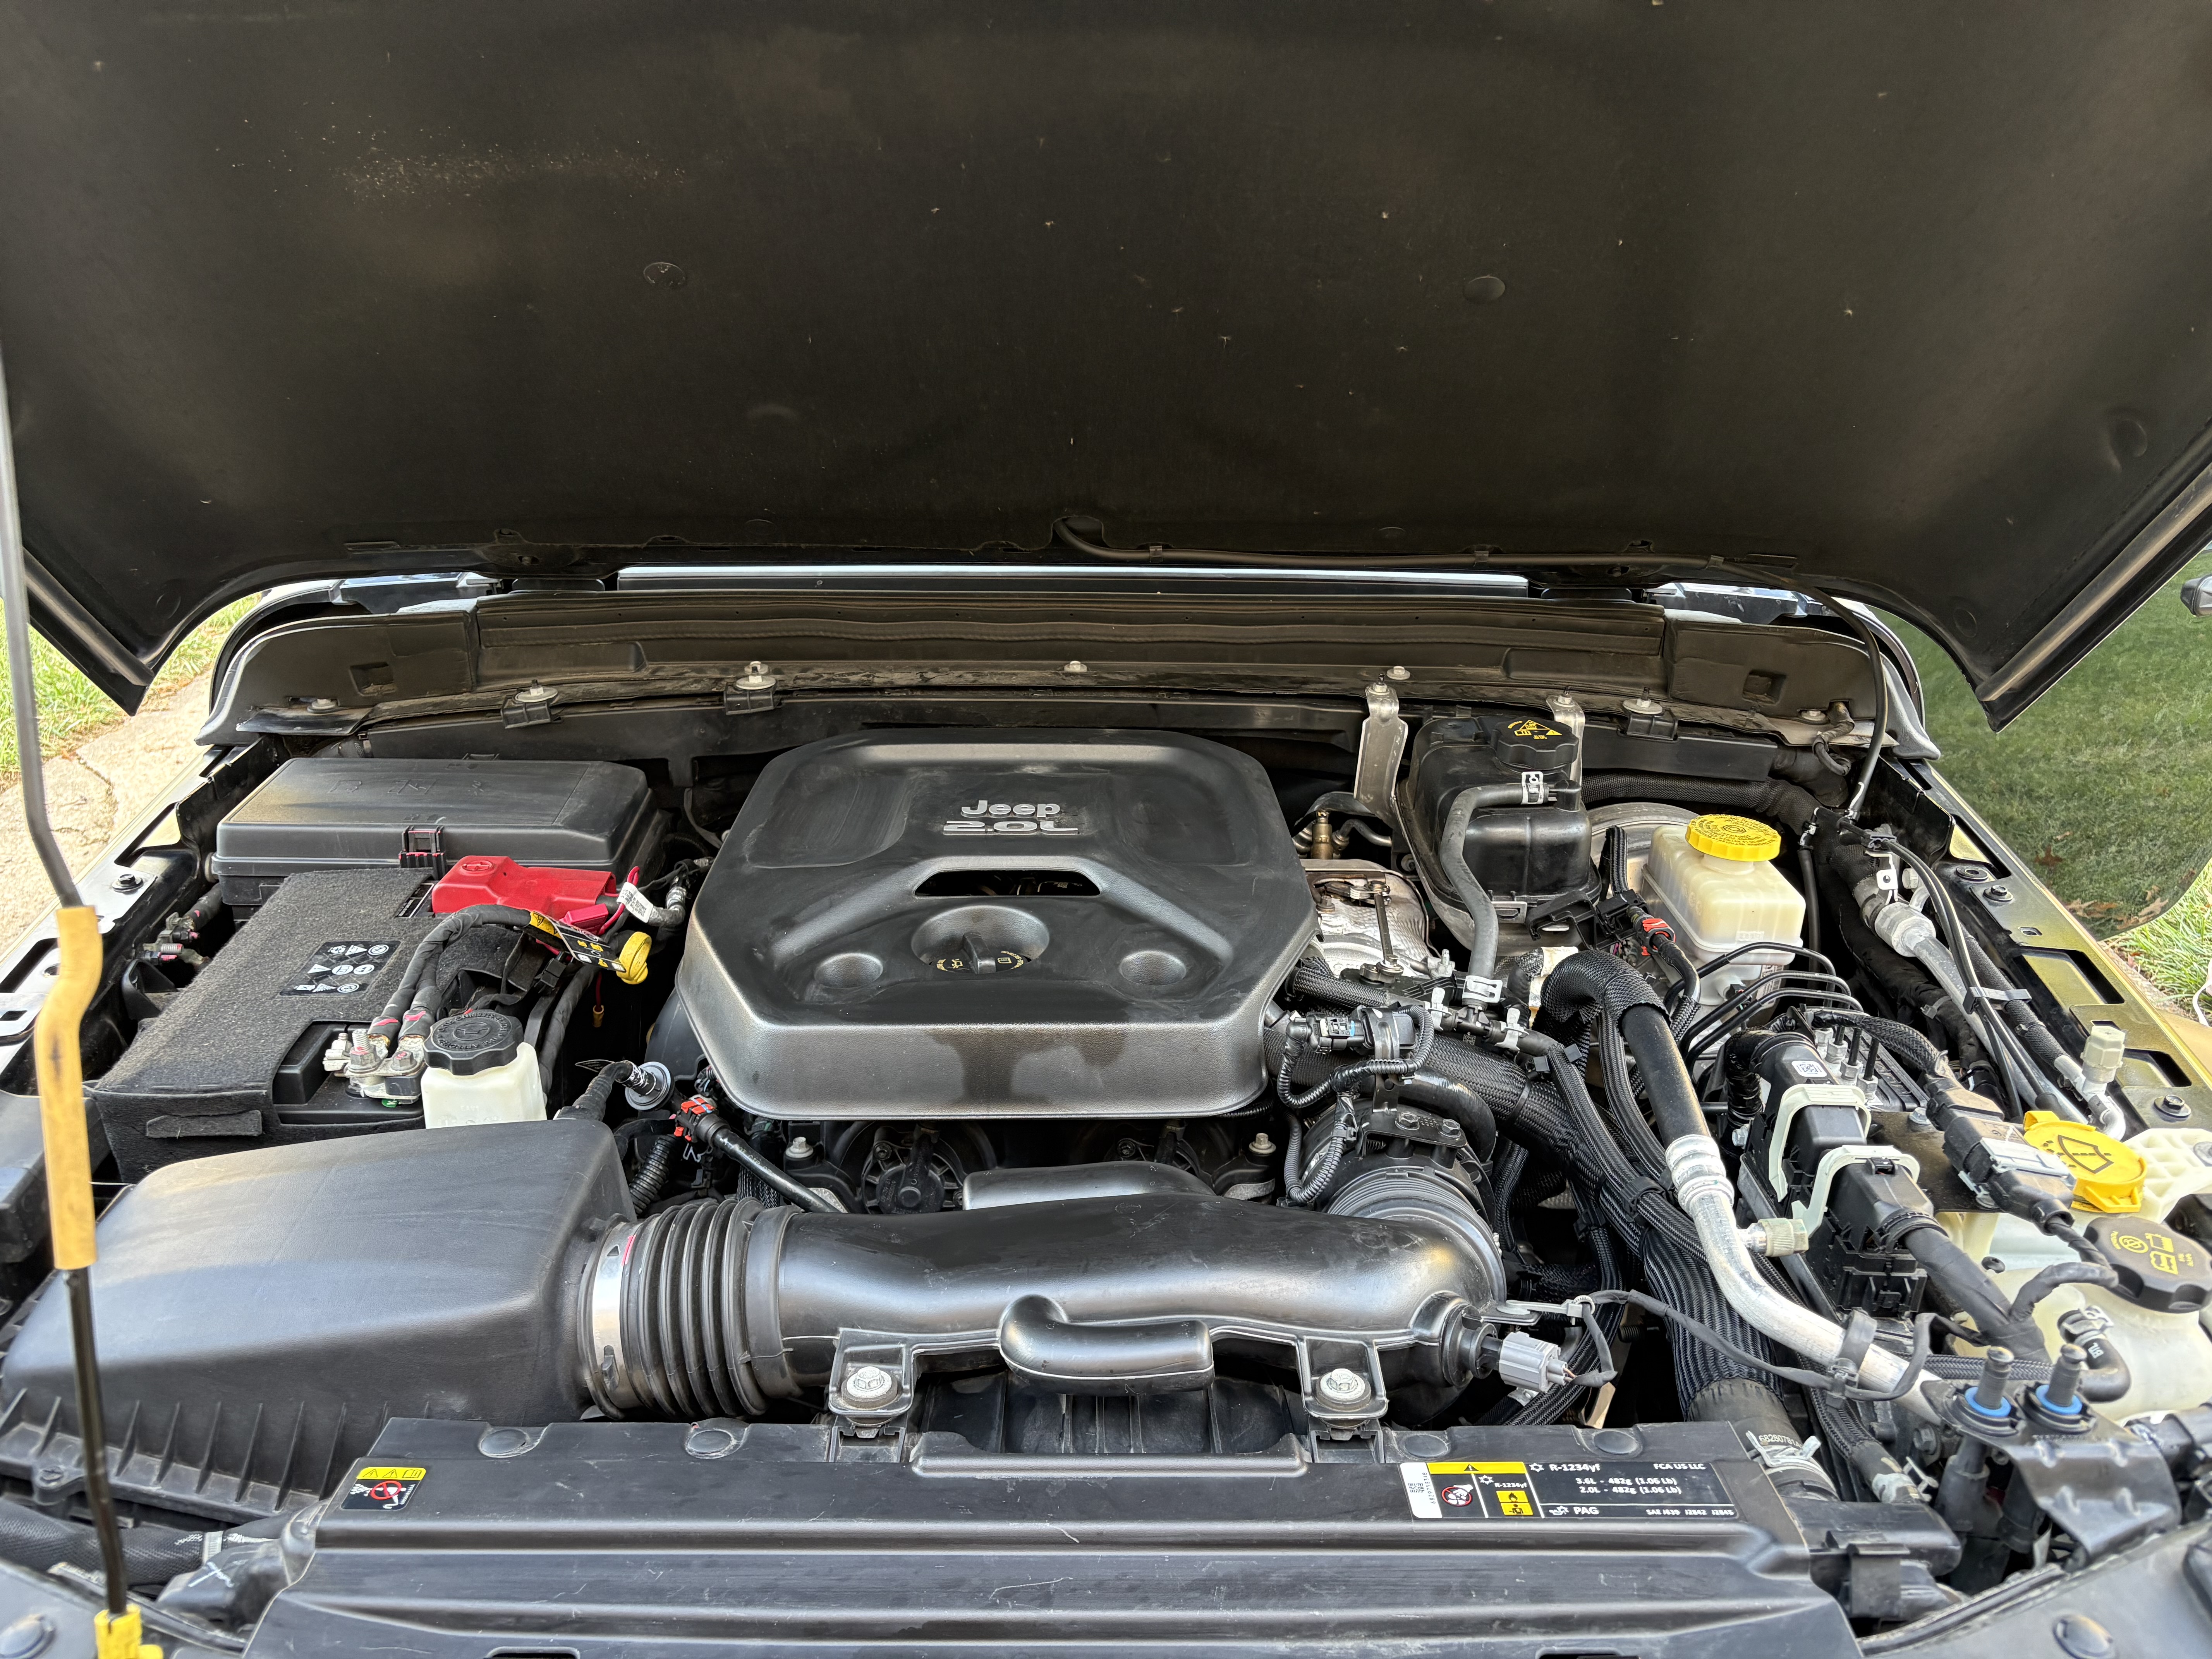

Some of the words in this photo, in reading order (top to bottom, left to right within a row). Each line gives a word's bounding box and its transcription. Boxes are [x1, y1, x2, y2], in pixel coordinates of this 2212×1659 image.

[961, 800, 1060, 819] Jeep
[943, 821, 1078, 833] 2.0L
[1549, 1463, 1601, 1472] R-1234yf
[1635, 1477, 1660, 1486] (1.06
[1661, 1477, 1677, 1486] Lb)
[1422, 1472, 1436, 1504] 68297583AB
[1612, 1486, 1637, 1494] 482g
[1639, 1486, 1665, 1494] (1.06
[1665, 1486, 1682, 1494] Lb)
[1573, 1506, 1599, 1515] PAG
